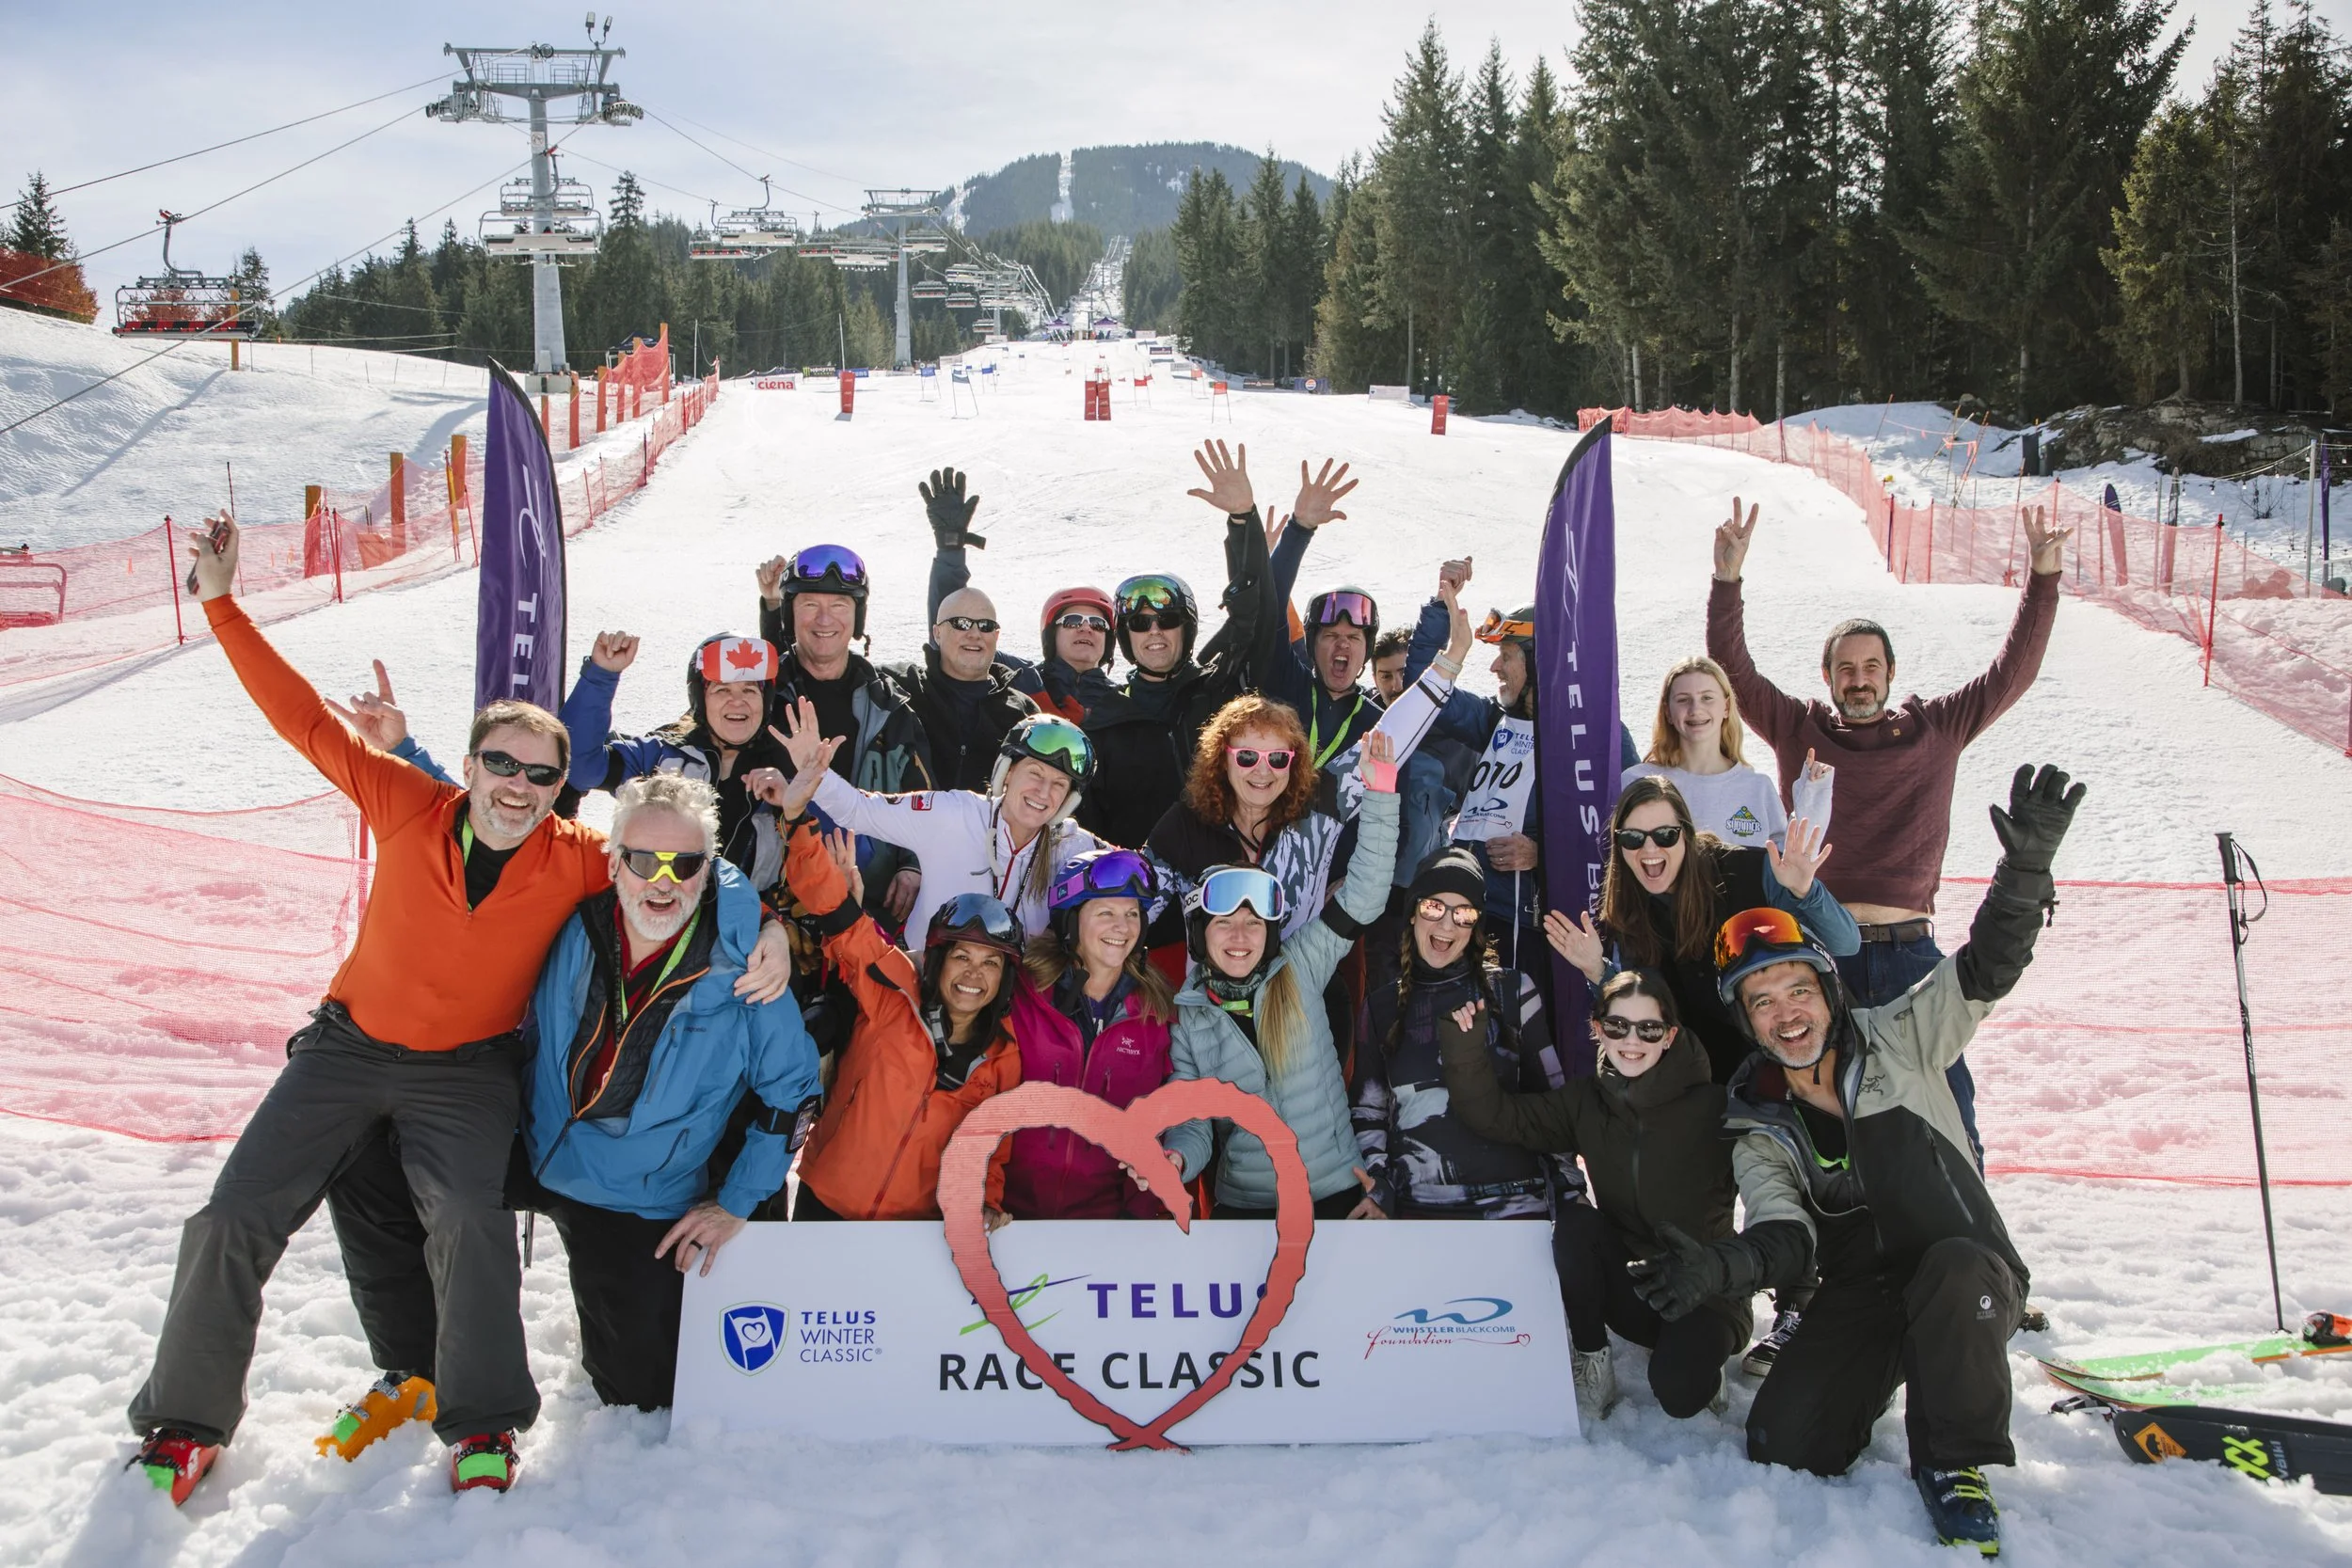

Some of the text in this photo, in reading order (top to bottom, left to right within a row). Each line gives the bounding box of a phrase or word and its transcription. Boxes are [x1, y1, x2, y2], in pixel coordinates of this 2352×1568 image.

[757, 378, 794, 390] ciena
[511, 593, 537, 698] TEL
[1566, 641, 1599, 836] TELUS
[1469, 760, 1523, 792] 010
[1185, 894, 1199, 906] OC
[1088, 1283, 1266, 1319] TELU
[801, 1310, 876, 1325] TELUS
[801, 1328, 874, 1344] WINTER
